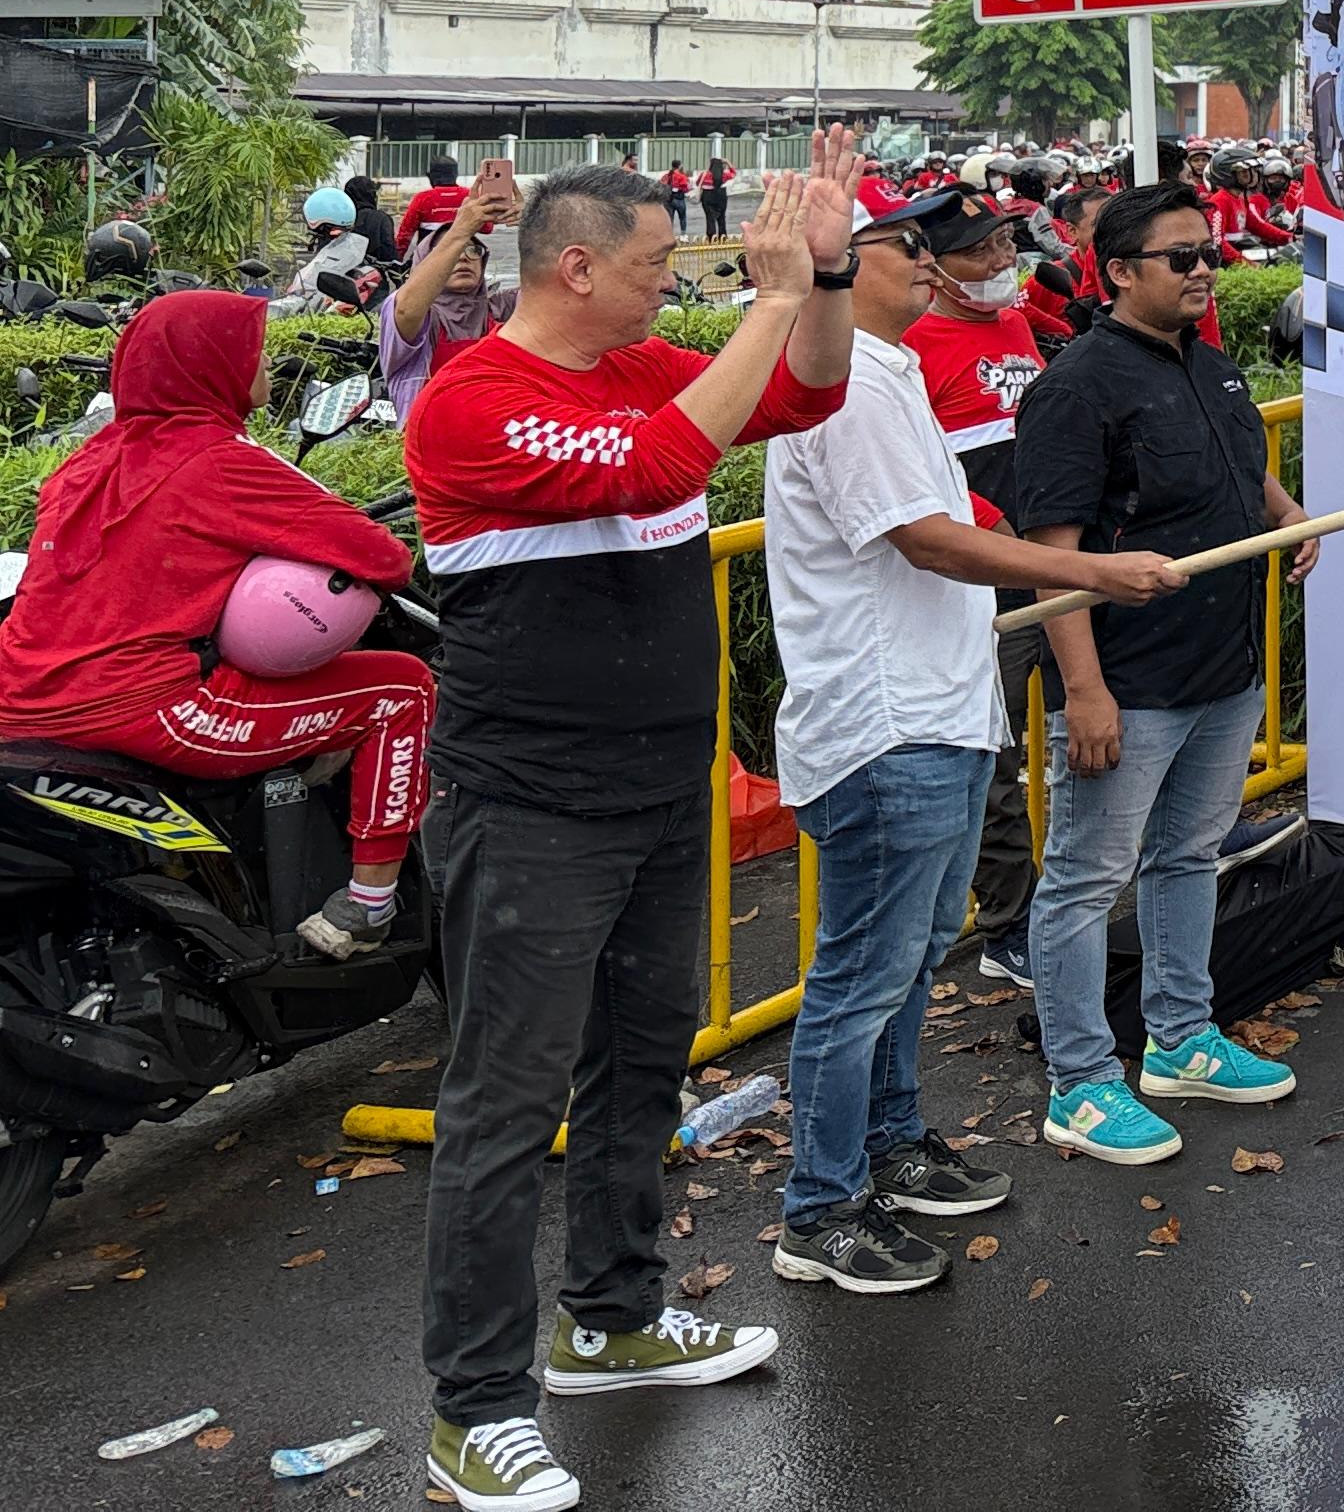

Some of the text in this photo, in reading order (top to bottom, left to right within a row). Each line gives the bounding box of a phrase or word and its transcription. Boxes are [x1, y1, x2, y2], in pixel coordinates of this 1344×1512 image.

[988, 368, 1041, 389] PARA
[649, 511, 706, 542] HONDA
[281, 707, 345, 741] FIGHT
[33, 775, 194, 828] VARIO
[821, 1230, 856, 1259] N
